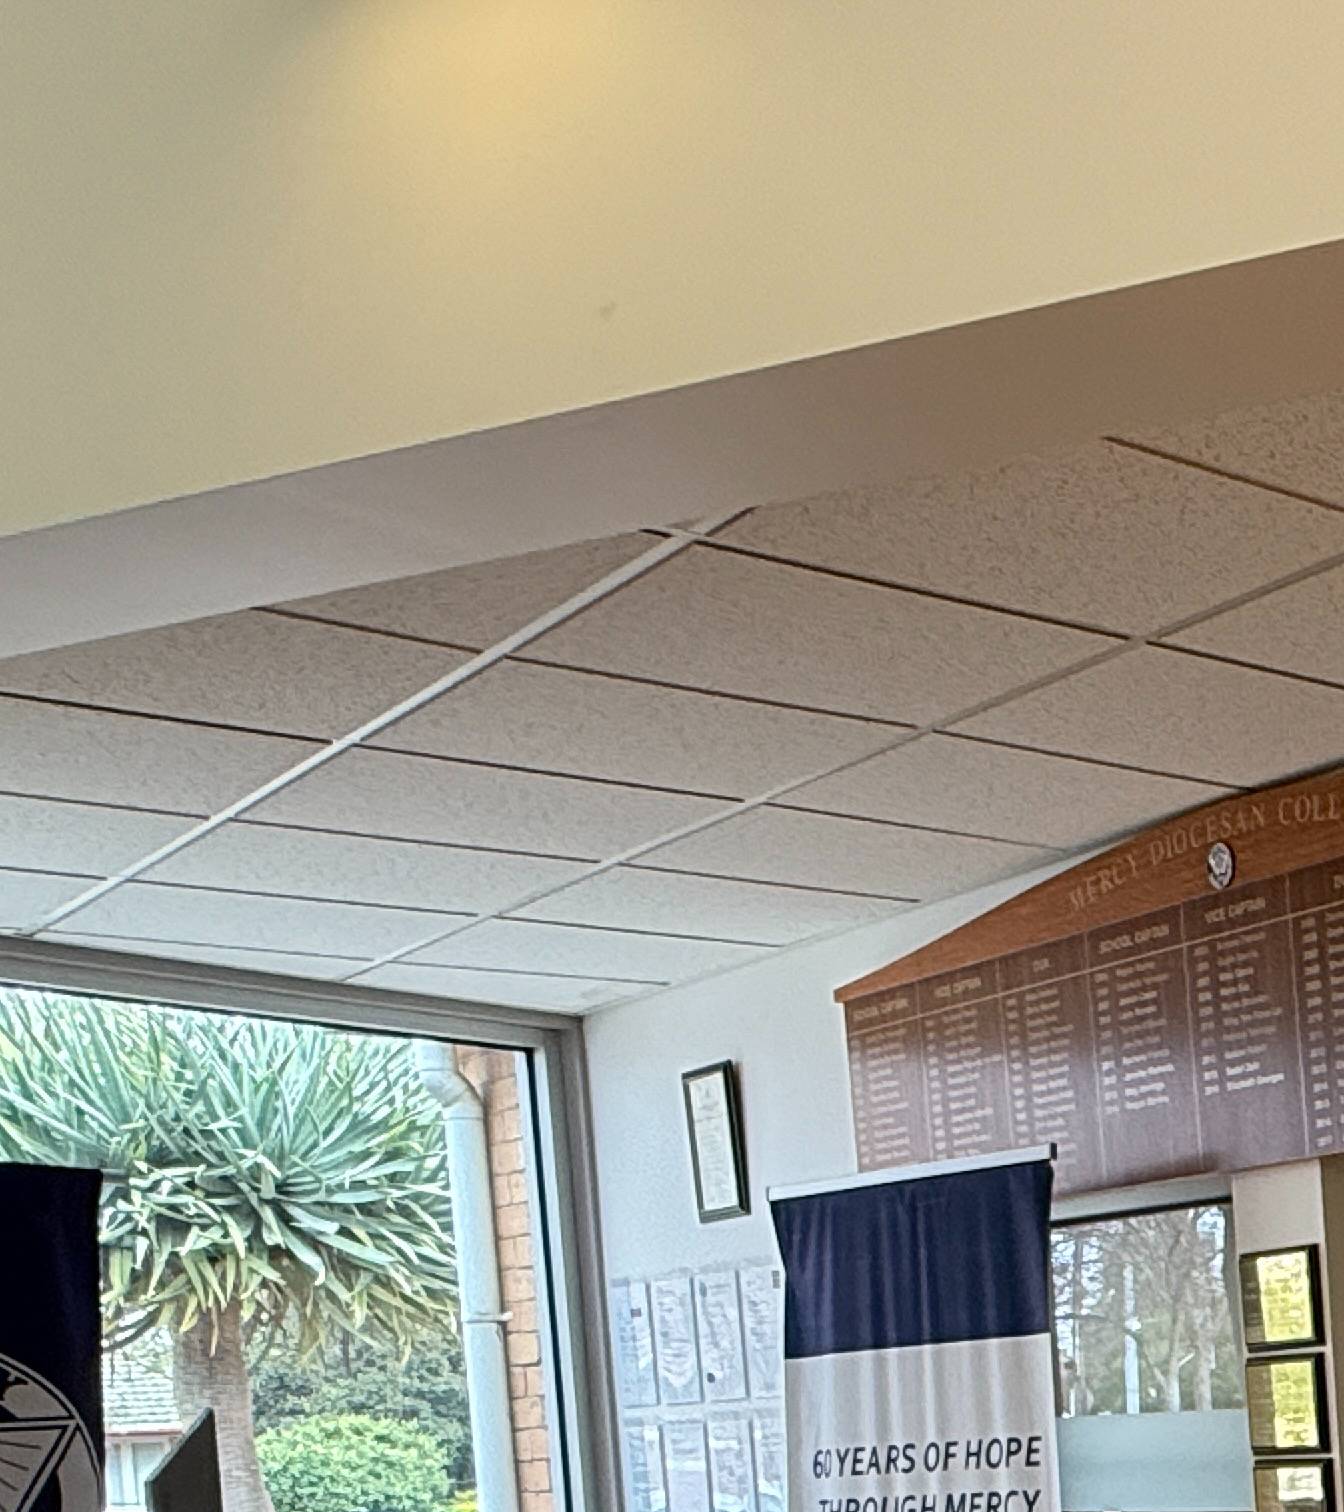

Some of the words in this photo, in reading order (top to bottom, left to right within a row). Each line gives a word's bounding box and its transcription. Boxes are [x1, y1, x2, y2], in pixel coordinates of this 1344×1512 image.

[1070, 853, 1140, 911] MERCY
[1149, 804, 1266, 867] DIOCESAN
[812, 1449, 832, 1479] 60
[837, 1443, 917, 1477] YEARS
[923, 1440, 959, 1473] OF
[964, 1435, 1042, 1470] HOPE
